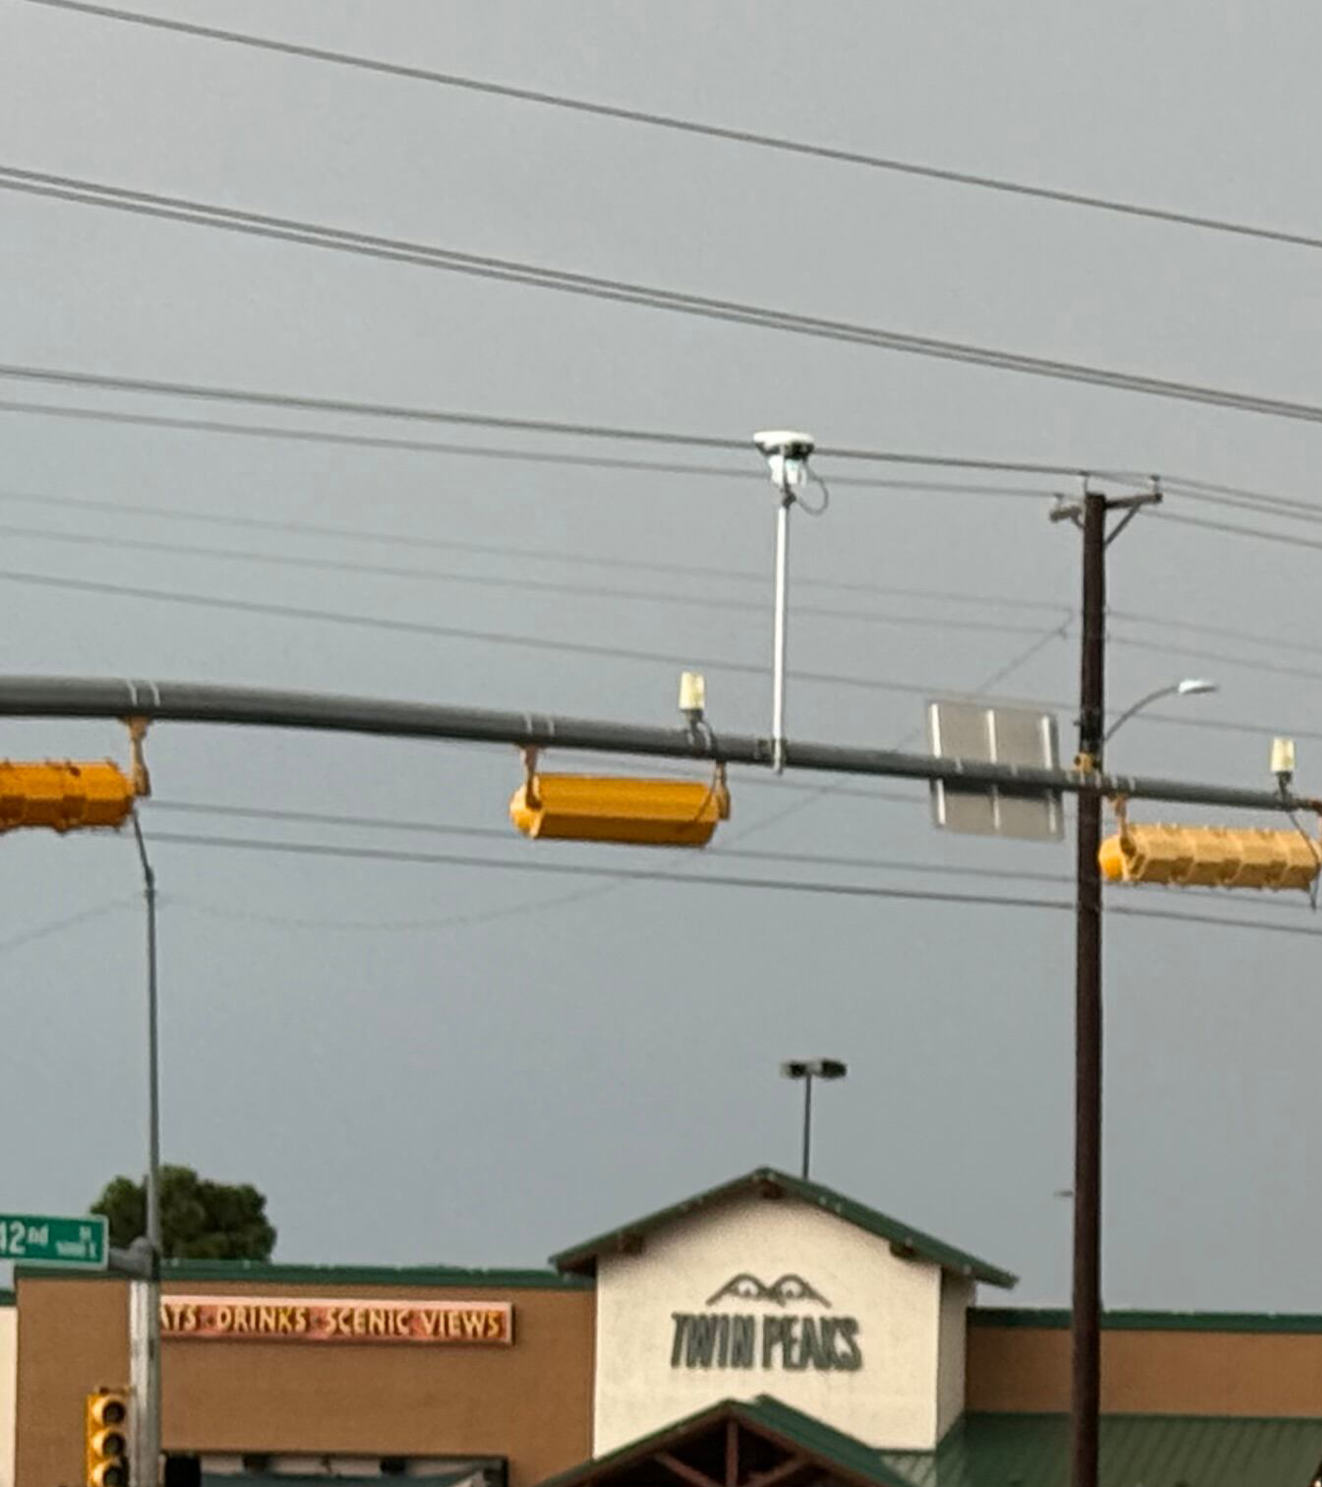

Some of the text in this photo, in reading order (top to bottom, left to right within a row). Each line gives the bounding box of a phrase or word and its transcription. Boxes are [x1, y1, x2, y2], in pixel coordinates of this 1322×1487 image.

[160, 1304, 499, 1338] ATS DRINKS SCENIC VIEWS
[671, 1312, 863, 1372] TWIN PEAKS
